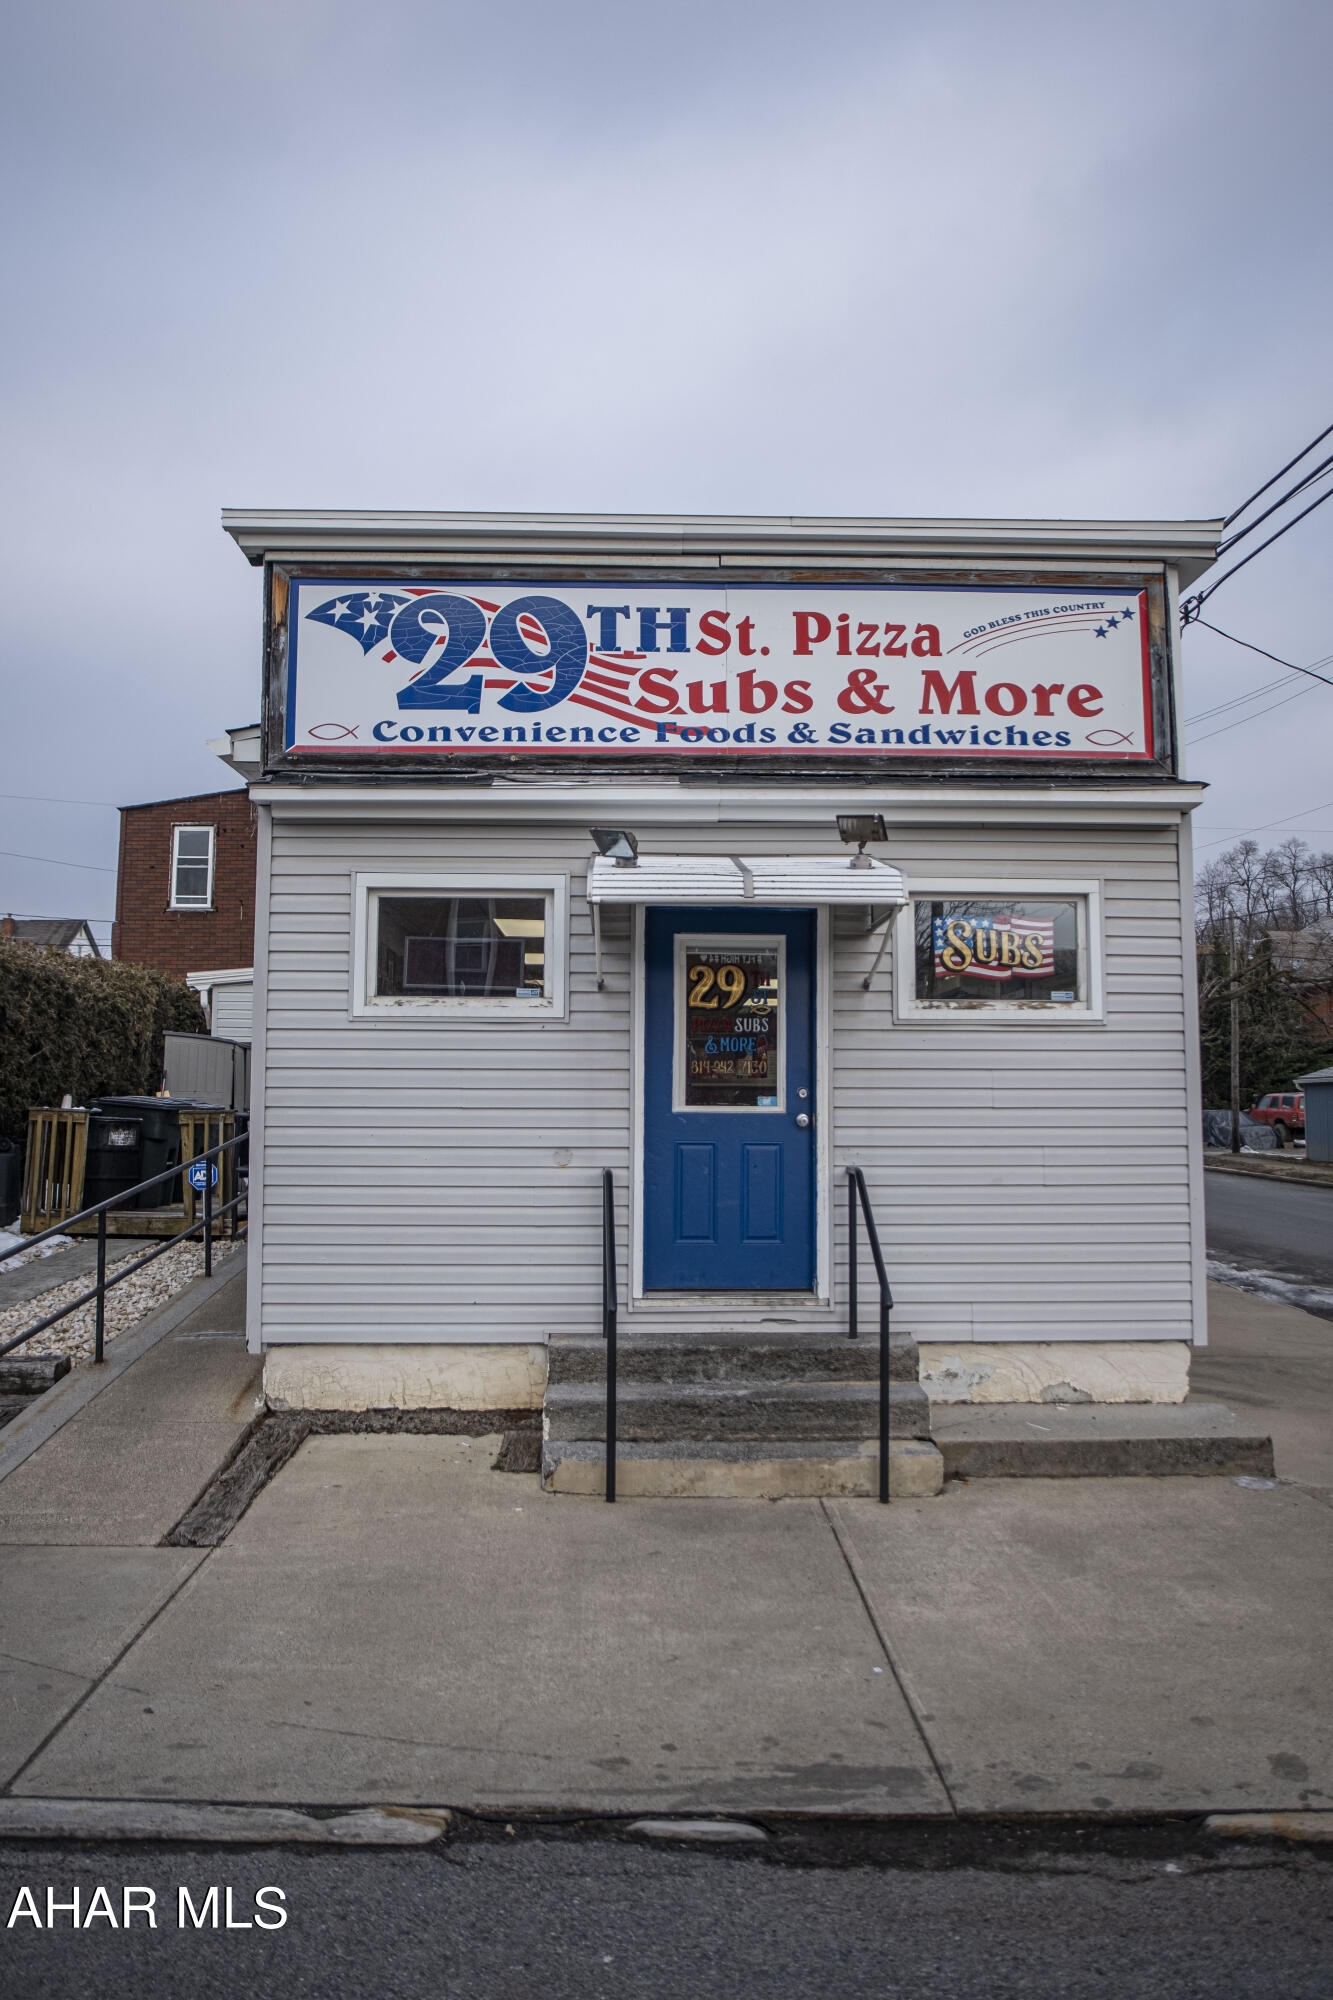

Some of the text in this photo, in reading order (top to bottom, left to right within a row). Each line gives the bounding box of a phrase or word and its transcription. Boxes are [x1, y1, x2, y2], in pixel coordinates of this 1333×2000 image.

[695, 609, 770, 657] St.
[793, 611, 943, 658] Pizza
[963, 601, 1106, 639] GOD BLESS THIS COUNTRY
[636, 667, 1105, 718] Subs & More
[372, 720, 1071, 747] Convenience Foods & Sandwiches
[734, 1016, 769, 1033] SUBS
[704, 1035, 757, 1055] & MORE
